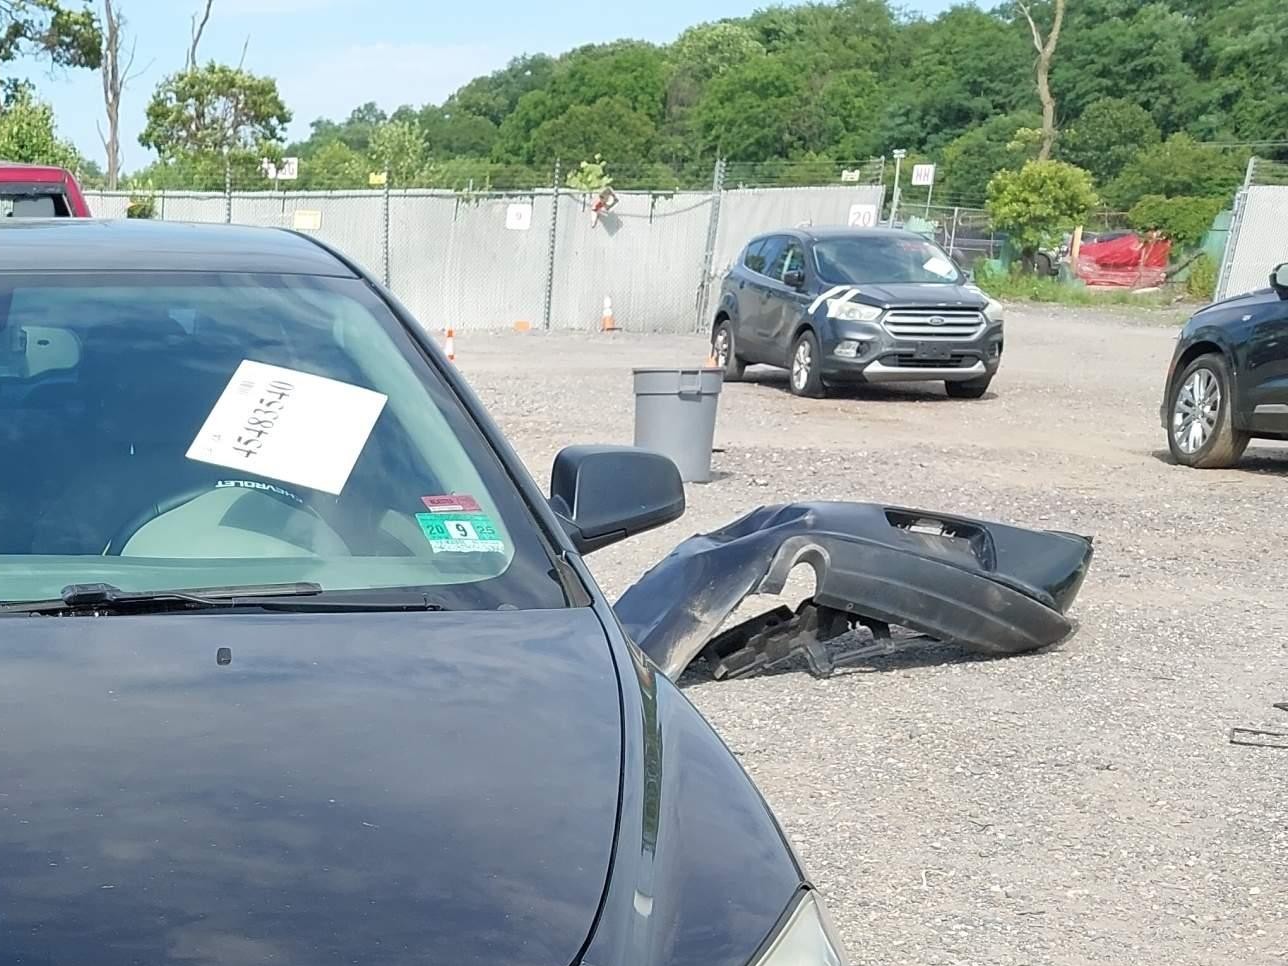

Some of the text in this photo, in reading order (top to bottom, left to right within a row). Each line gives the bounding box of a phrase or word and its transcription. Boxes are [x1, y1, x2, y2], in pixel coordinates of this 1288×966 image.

[851, 211, 872, 226] 20
[233, 380, 295, 458] 45483540
[426, 523, 495, 537] 20 9 25
